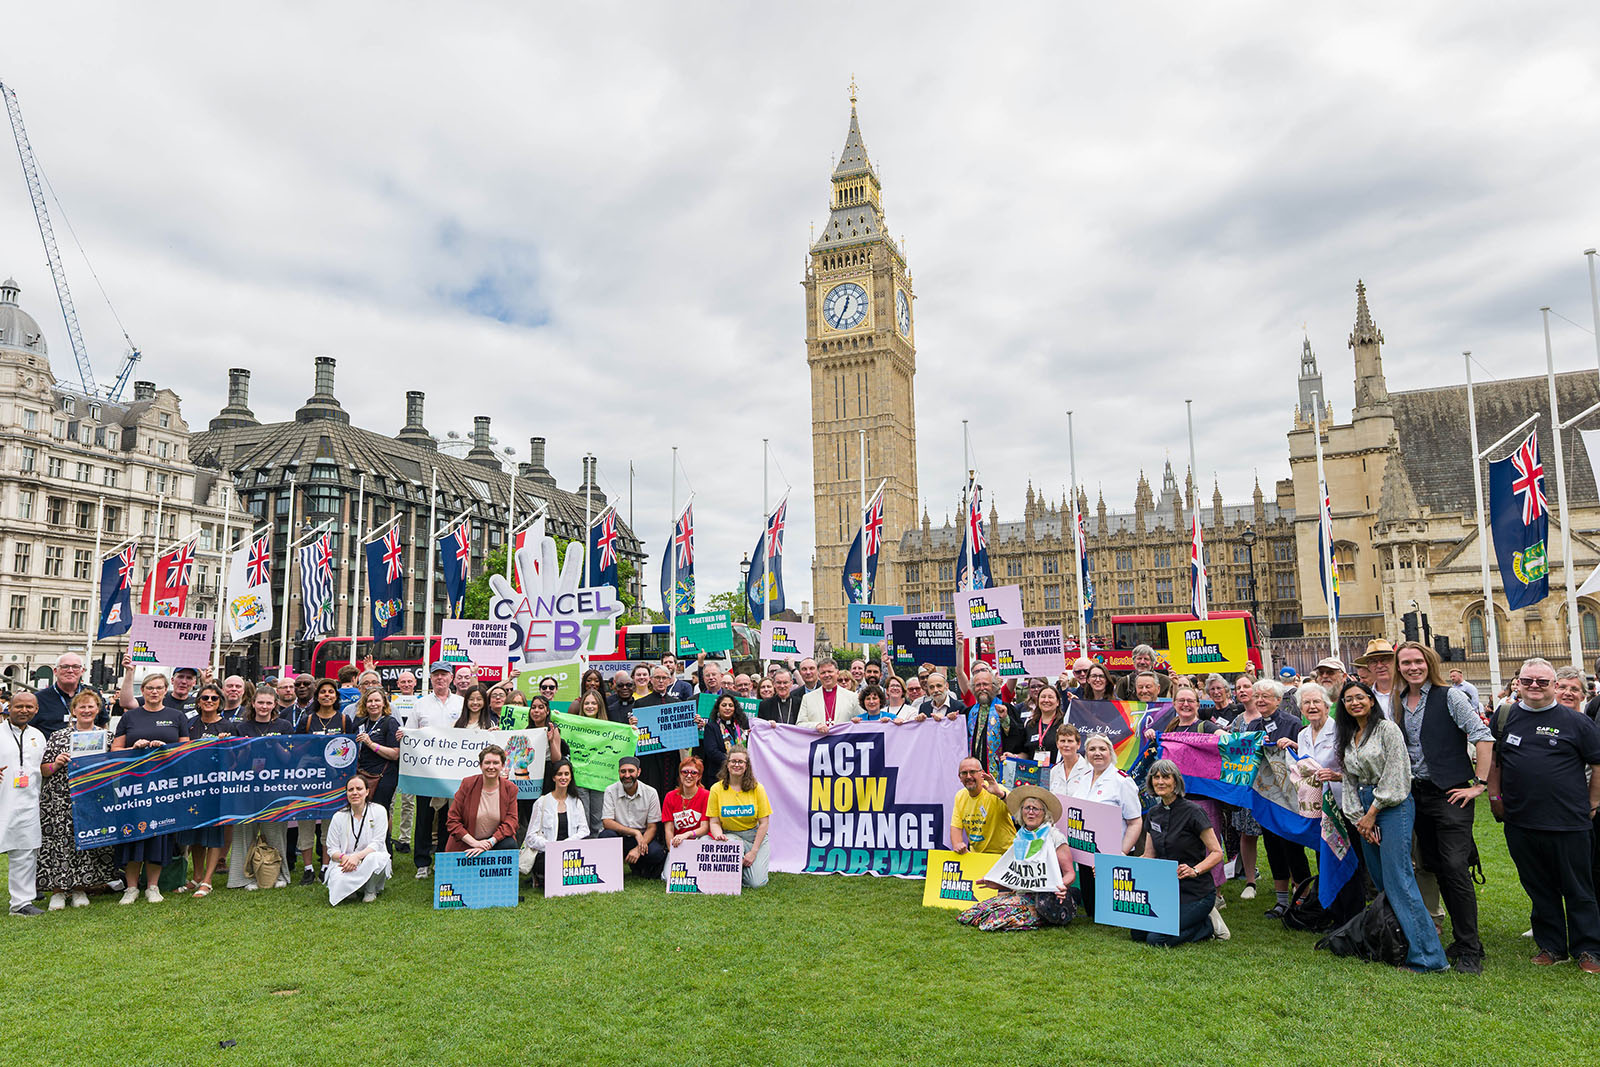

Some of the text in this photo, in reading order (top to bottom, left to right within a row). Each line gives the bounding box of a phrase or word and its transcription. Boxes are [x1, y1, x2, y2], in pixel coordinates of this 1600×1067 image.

[494, 591, 611, 620] CANCEL
[688, 616, 715, 624] TOGETHER
[971, 611, 997, 620] CHANGE
[154, 620, 207, 631] TOGETHER FOR
[972, 617, 1001, 628] FOREVER
[179, 632, 206, 641] PEOPLE
[1186, 631, 1200, 640] ACT
[1033, 638, 1060, 646] CLIMATE
[1186, 639, 1204, 647] NOW
[1187, 645, 1217, 655] CHANGE
[1187, 653, 1221, 663] FOREVER
[382, 669, 411, 680] SAV
[673, 704, 694, 713] PEOPLE
[657, 712, 694, 723] FOR CLIMATE
[673, 720, 695, 729] NATURE
[402, 735, 420, 748] Cry
[424, 737, 436, 747] of
[439, 738, 457, 749] the
[611, 732, 631, 743] Jesus
[638, 737, 659, 746] CHANGE
[402, 753, 480, 768] Cry of the Poo
[812, 742, 874, 776] ACT
[114, 768, 326, 798] WE ARE PILGRIMS OF HOPE
[103, 798, 152, 813] working
[155, 788, 206, 803] together
[222, 784, 250, 794] build
[264, 784, 298, 792] better
[301, 781, 332, 790] world
[811, 777, 888, 812] NOW
[723, 806, 752, 815] tearfund
[1069, 809, 1080, 820] ACT
[676, 812, 696, 828] aid
[1068, 818, 1082, 831] NOW
[811, 812, 935, 849] CHANGE
[1068, 827, 1093, 843] CHANGE
[702, 844, 740, 853] FOR PEOPLE
[1068, 836, 1095, 852] FOREVER
[456, 856, 512, 866] TOGETHER FOR
[564, 851, 579, 860] ACT
[711, 854, 740, 862] CLIMATE
[563, 859, 582, 868] NOW
[713, 864, 739, 872] NATURE
[805, 848, 927, 877] FOREVE
[943, 863, 958, 873] ACT
[480, 868, 512, 877] CLIMATE
[563, 866, 594, 876] CHANGE
[1037, 863, 1046, 876] SI
[1113, 869, 1129, 880] ACT
[563, 874, 598, 885] FOREVER
[943, 872, 961, 880] NOW
[942, 880, 971, 891] CHANGE
[1113, 880, 1133, 892] NOW
[940, 889, 972, 900] FOREVER
[1113, 890, 1146, 904] CHANGE
[1113, 900, 1150, 915] FOREVER
